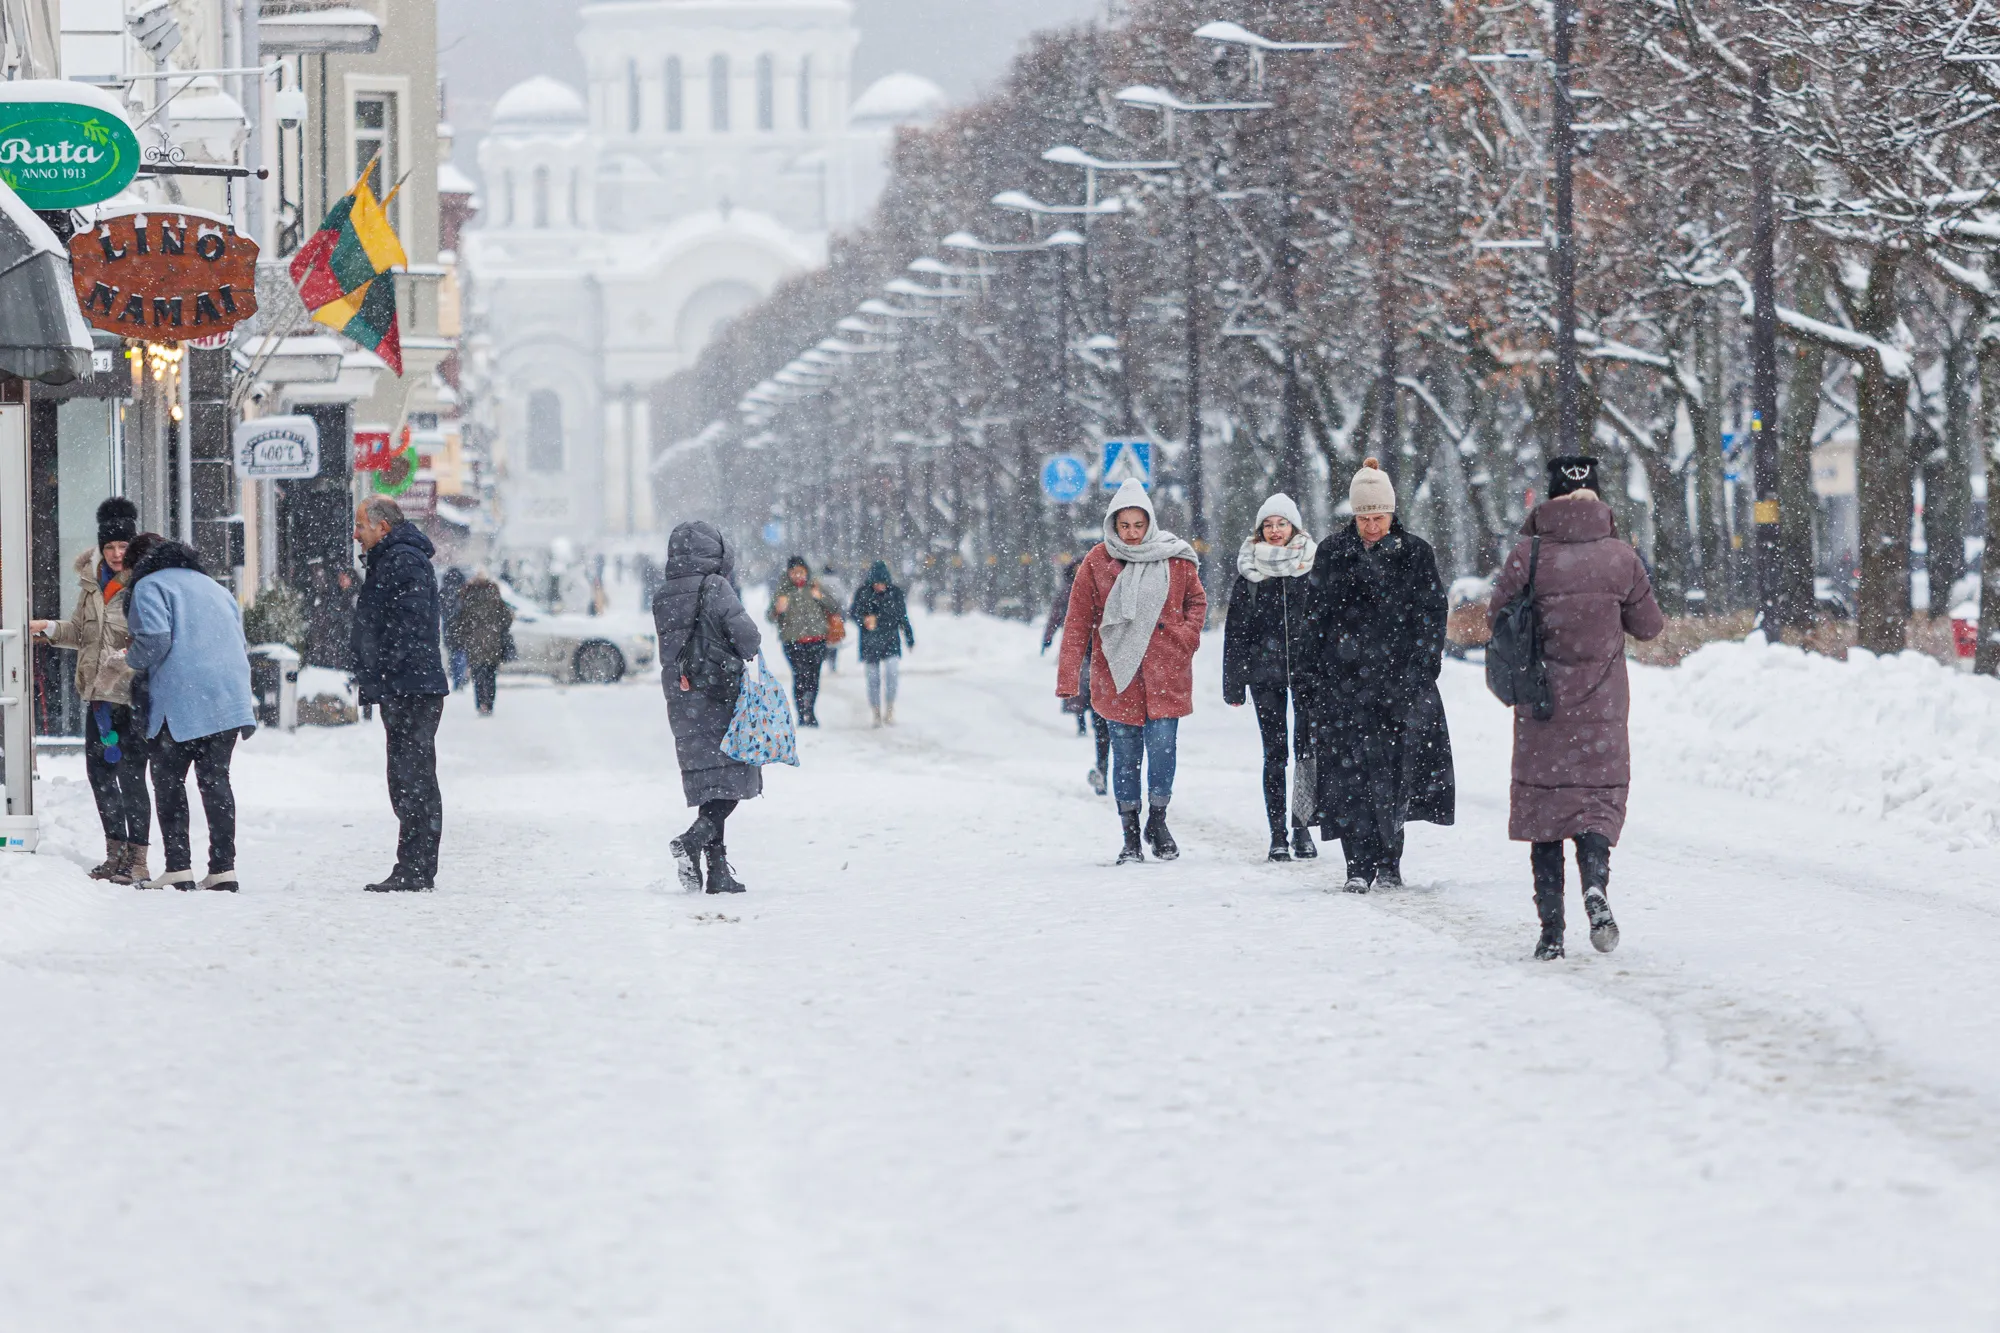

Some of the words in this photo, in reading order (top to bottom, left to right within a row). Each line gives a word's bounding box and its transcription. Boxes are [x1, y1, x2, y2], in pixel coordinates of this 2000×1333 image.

[22, 168, 58, 179] ANNO
[62, 168, 86, 179] 1913
[98, 226, 226, 263] LINO
[86, 282, 238, 328] NAMAI
